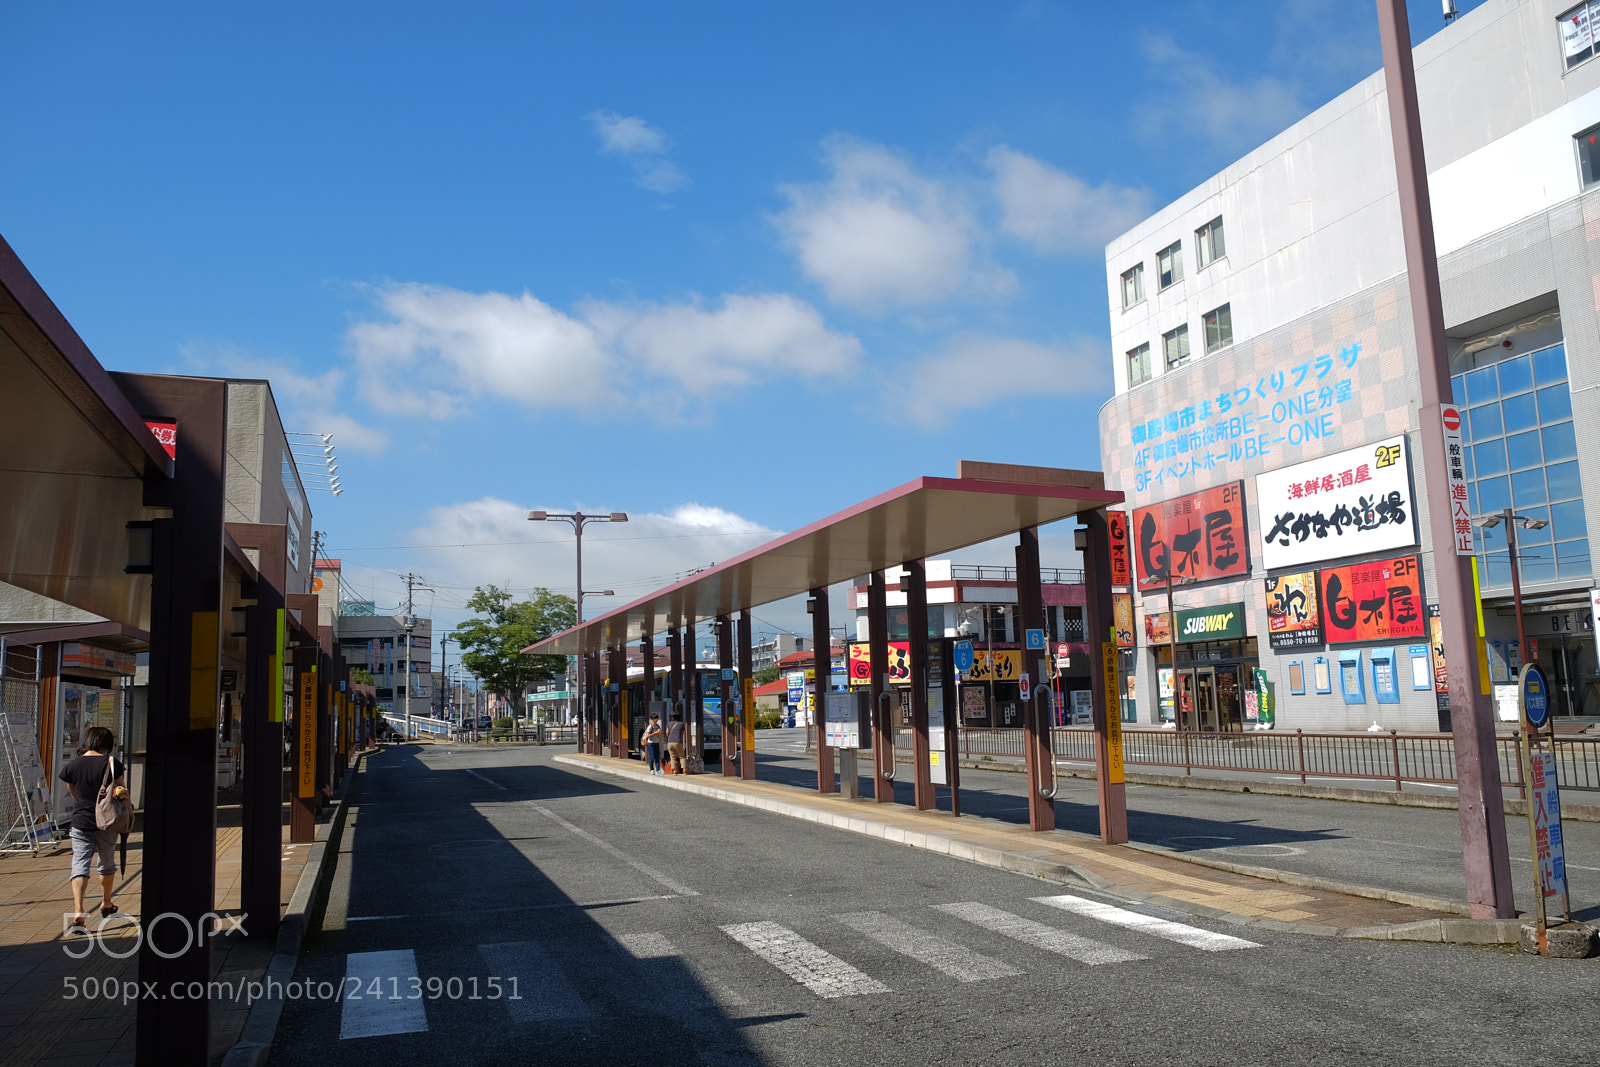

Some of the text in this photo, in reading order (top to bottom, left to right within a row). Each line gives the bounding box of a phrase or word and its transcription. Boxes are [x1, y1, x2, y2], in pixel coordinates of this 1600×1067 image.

[1134, 447, 1150, 468] 4F
[1375, 444, 1401, 469] 2F
[1135, 470, 1152, 492] 3F
[1288, 464, 1373, 500] 海鮮居酒屋
[1223, 485, 1238, 504] 2F
[1265, 491, 1407, 546] さかなや道場
[1140, 509, 1240, 582] 白木屋
[1351, 569, 1381, 585] 居楽屋
[1394, 558, 1416, 577] 2F
[1266, 579, 1276, 590] 1F
[1326, 573, 1418, 630] 白木屋
[1183, 611, 1234, 635] SUBWAY
[1376, 625, 1421, 635] SHIROKIYA
[1031, 633, 1040, 646] 6
[961, 652, 967, 666] 6
[979, 651, 1004, 660] ラメン
[725, 670, 730, 678] 5
[1530, 756, 1557, 898] 進入禁止
